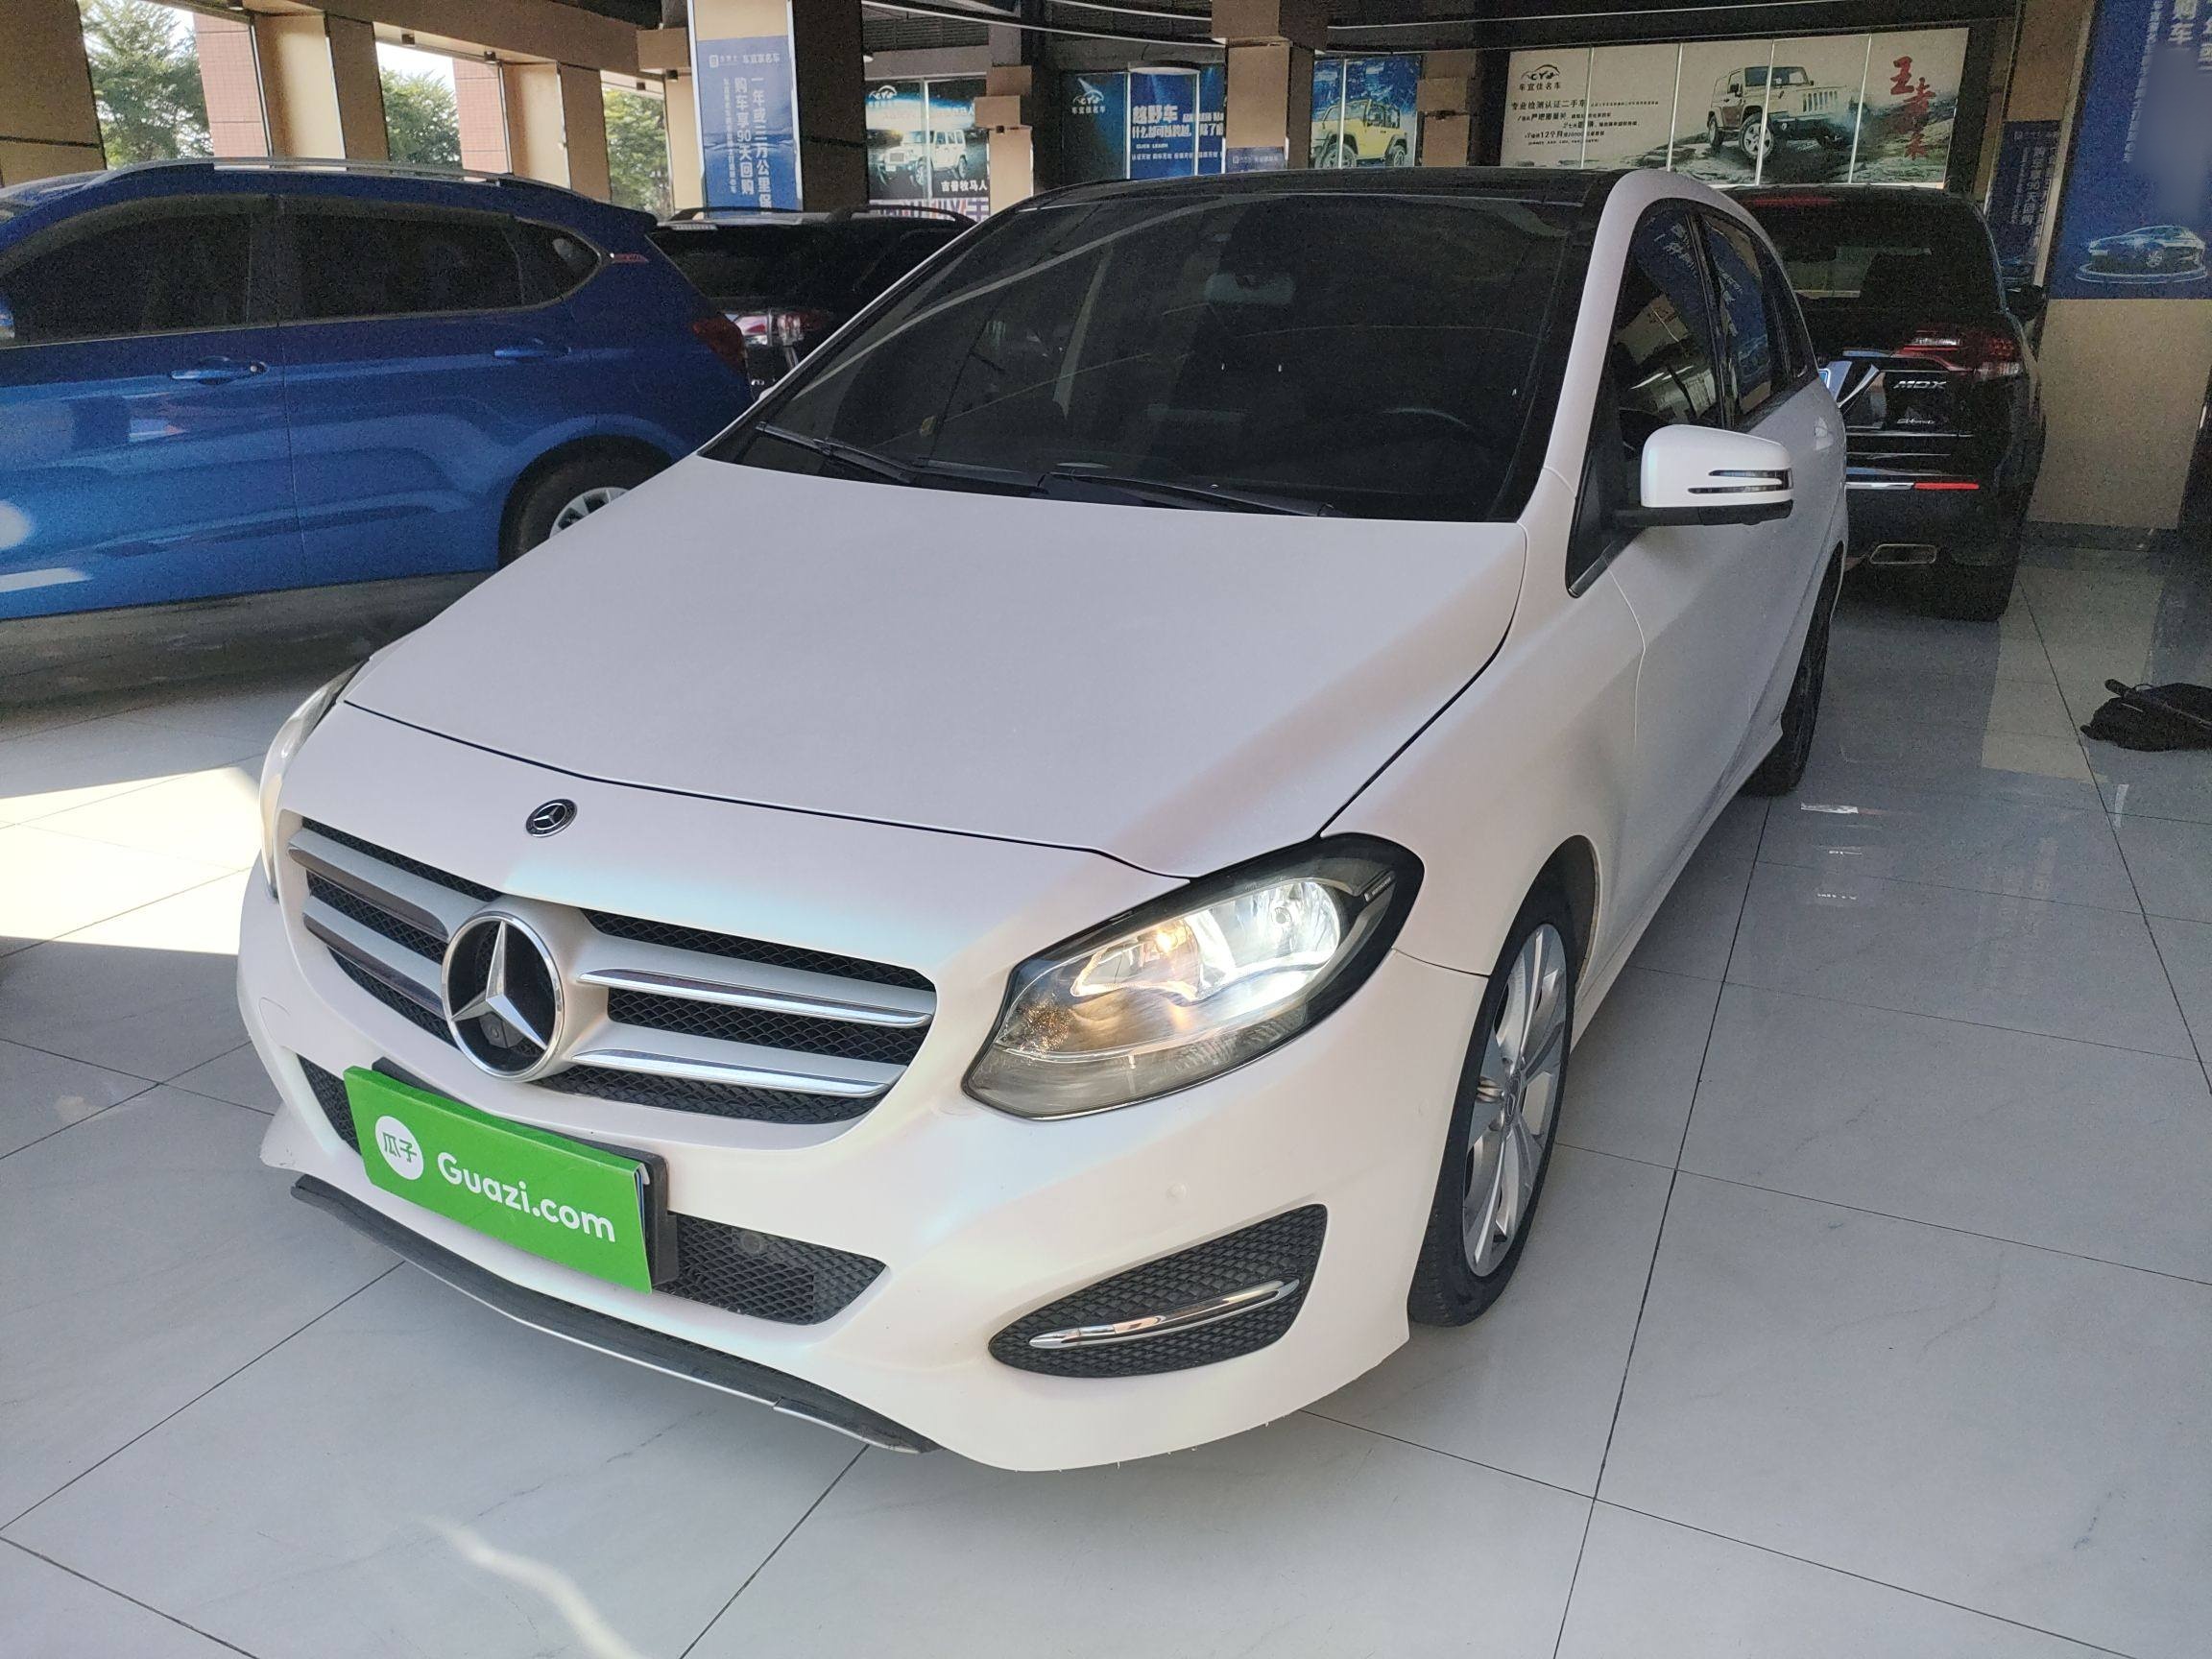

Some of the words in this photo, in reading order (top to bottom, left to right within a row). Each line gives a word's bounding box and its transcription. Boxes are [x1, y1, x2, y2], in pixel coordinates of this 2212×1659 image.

[1132, 105, 1178, 124] 越野车
[751, 77, 772, 215] 一年或三万公里保
[1893, 380, 1947, 390] MDX
[382, 1131, 418, 1163] 瓜子
[437, 1151, 616, 1243] Guazi.com
